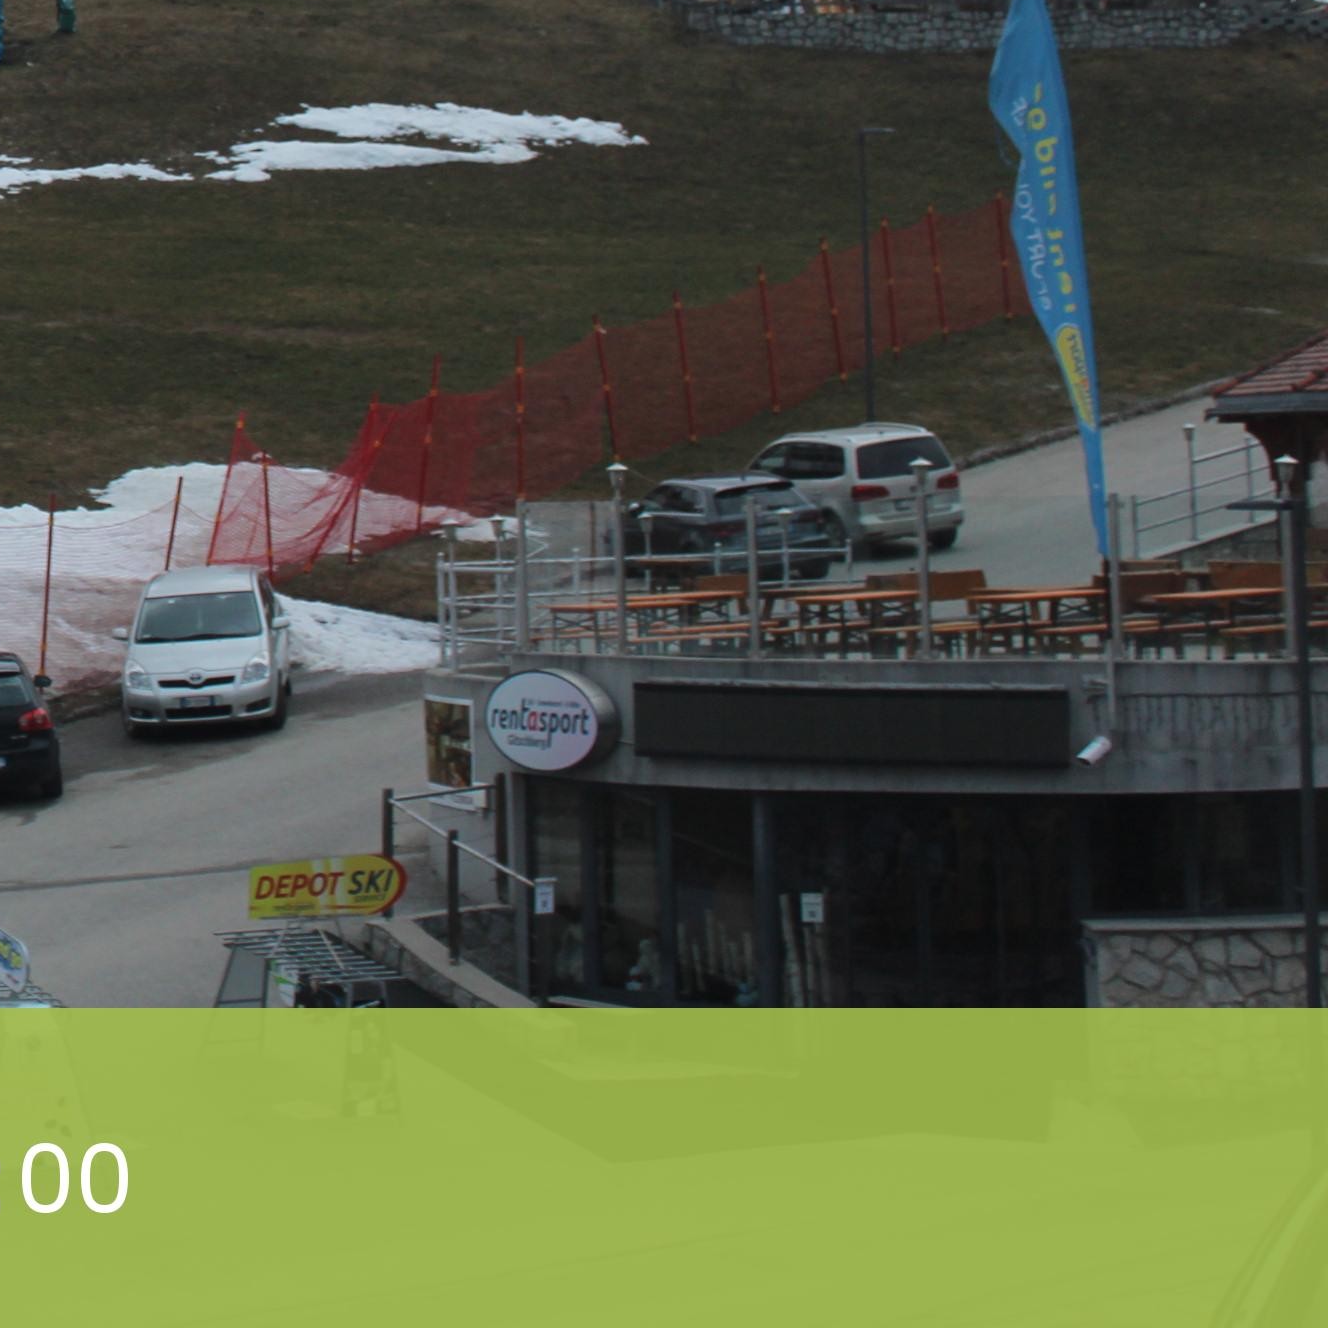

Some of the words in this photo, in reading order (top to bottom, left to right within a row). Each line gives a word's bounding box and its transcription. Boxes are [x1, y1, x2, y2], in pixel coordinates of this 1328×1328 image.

[490, 697, 590, 749] rentasport
[255, 871, 345, 900] DEPOT
[347, 869, 393, 895] SKI
